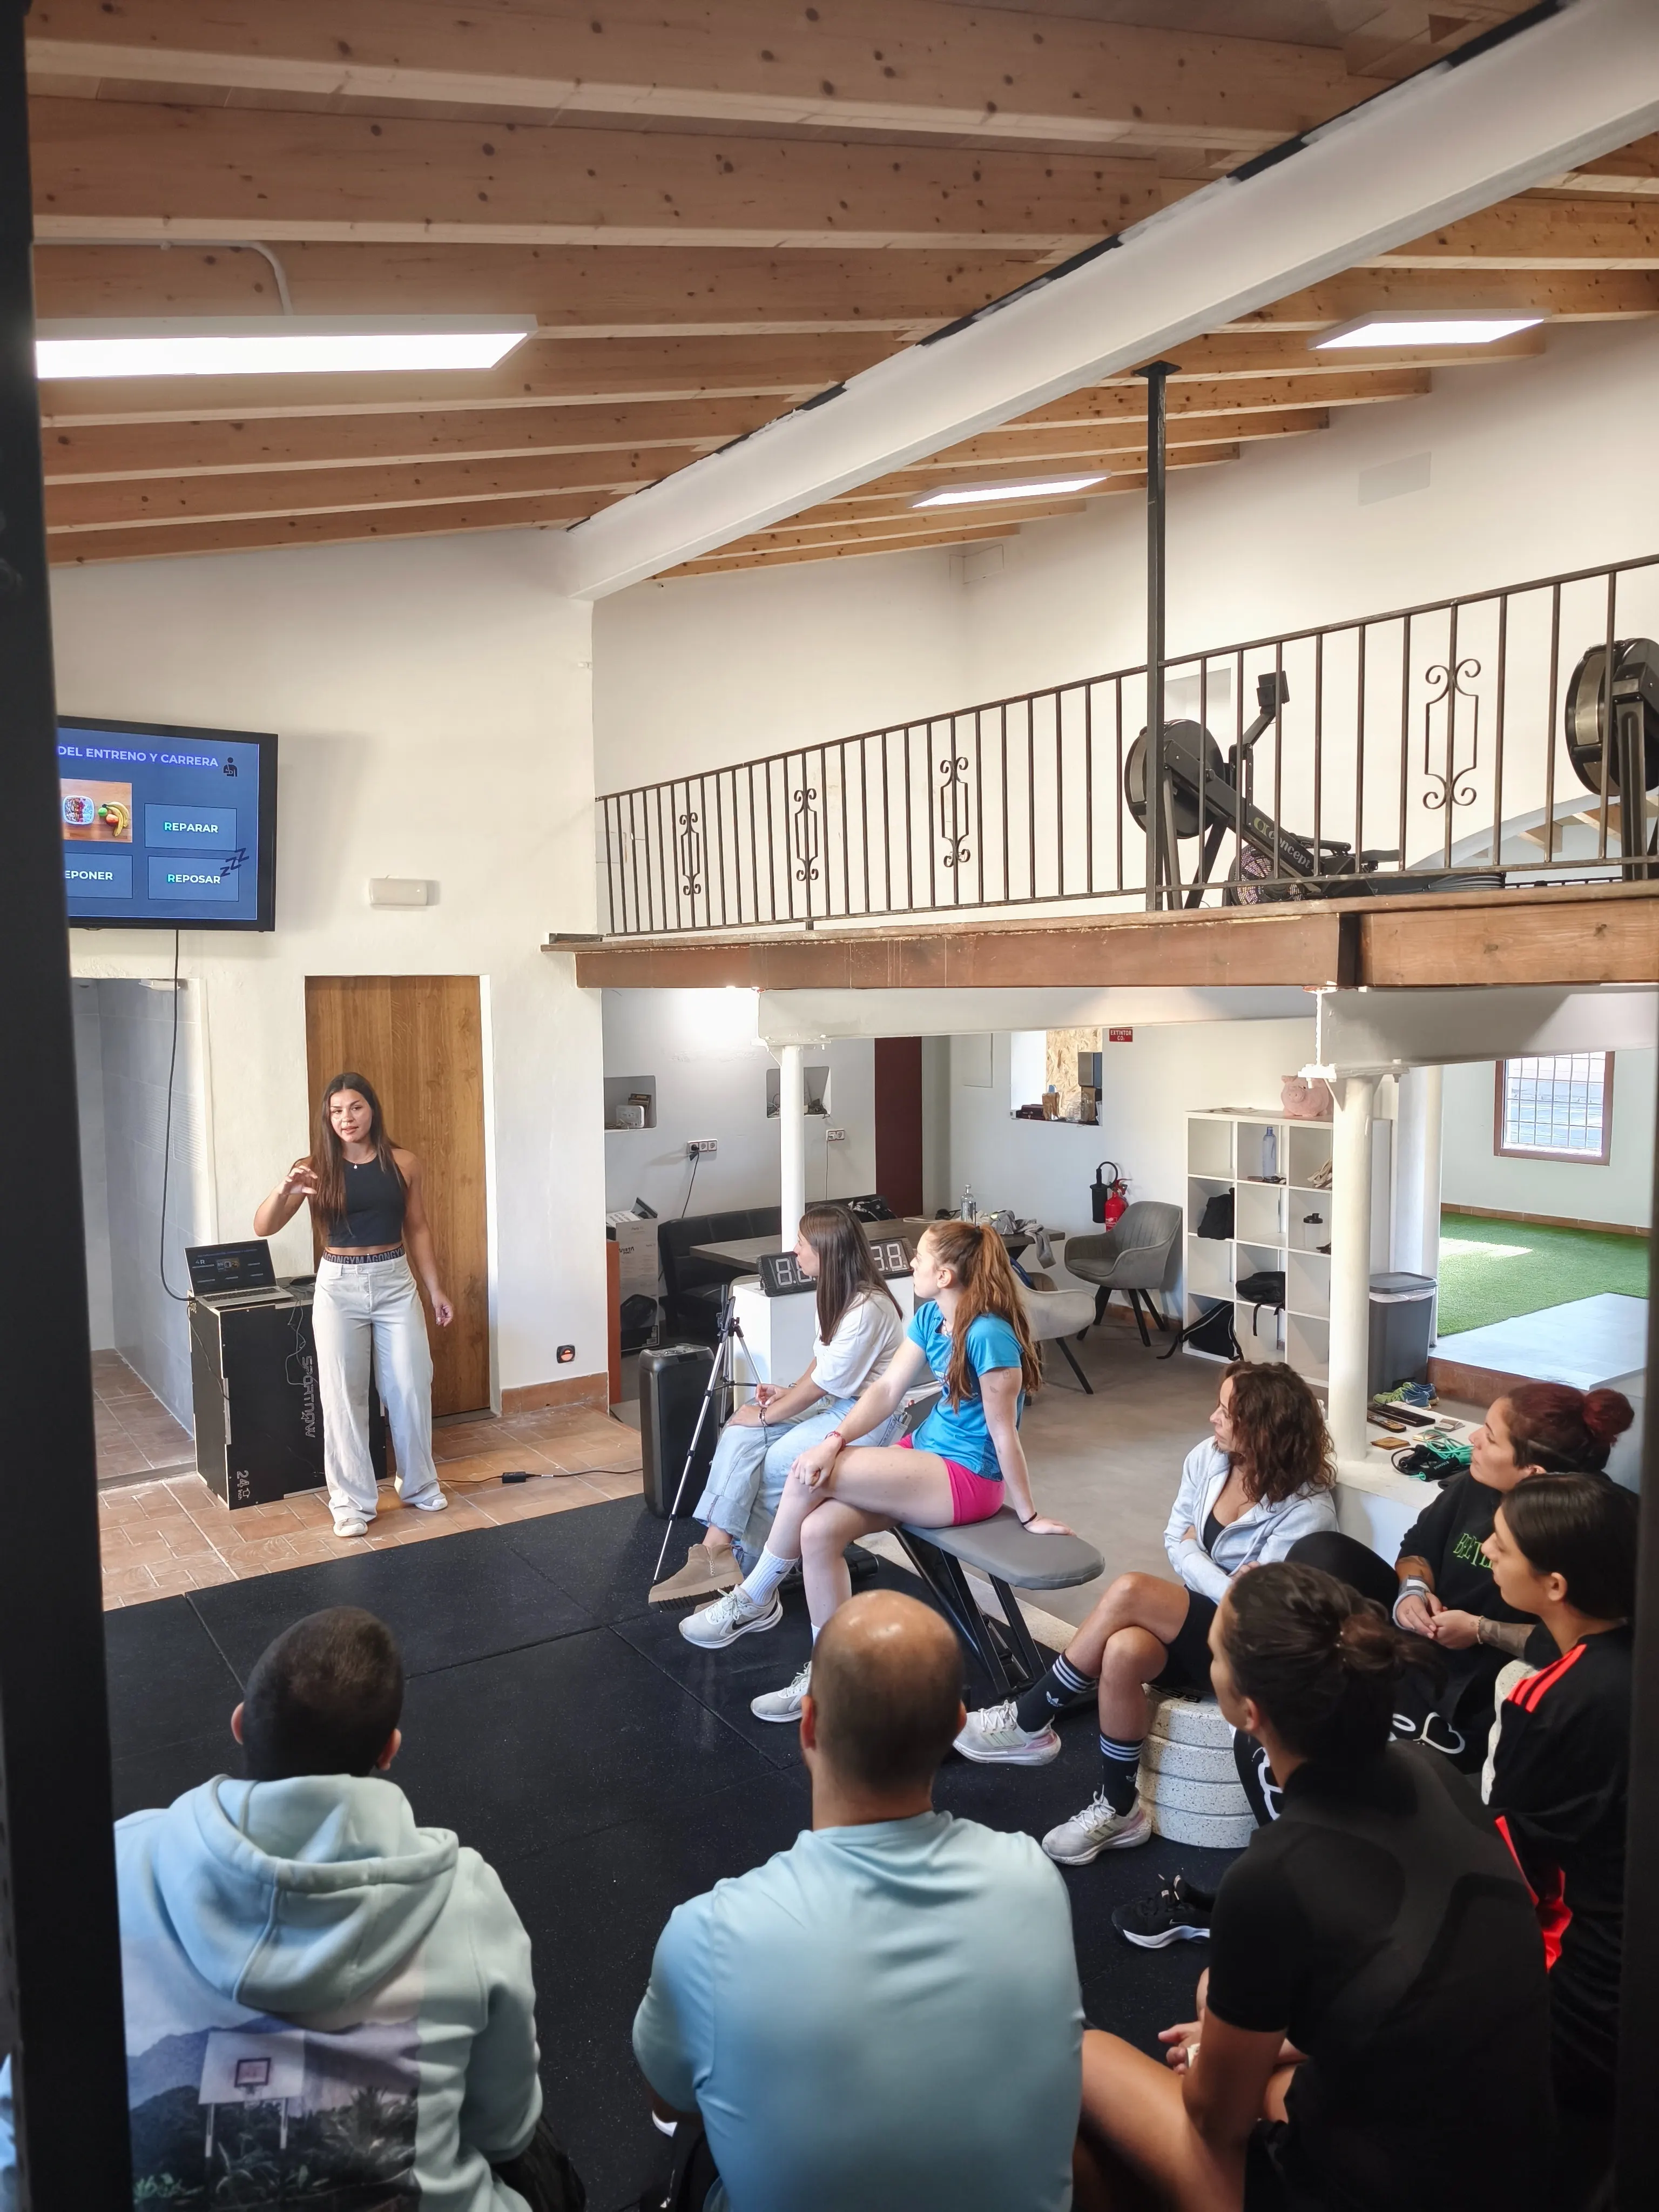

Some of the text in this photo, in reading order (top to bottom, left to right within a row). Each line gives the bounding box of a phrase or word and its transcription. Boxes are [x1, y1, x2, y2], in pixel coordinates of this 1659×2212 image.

[58, 746, 219, 767] DEL ENTRENO Y CARRERA
[164, 822, 218, 833] REPARAR
[1268, 831, 1310, 868] cncept
[65, 870, 113, 880] EPONER
[167, 874, 221, 884] REPOSAR
[237, 1470, 249, 1488] 24
